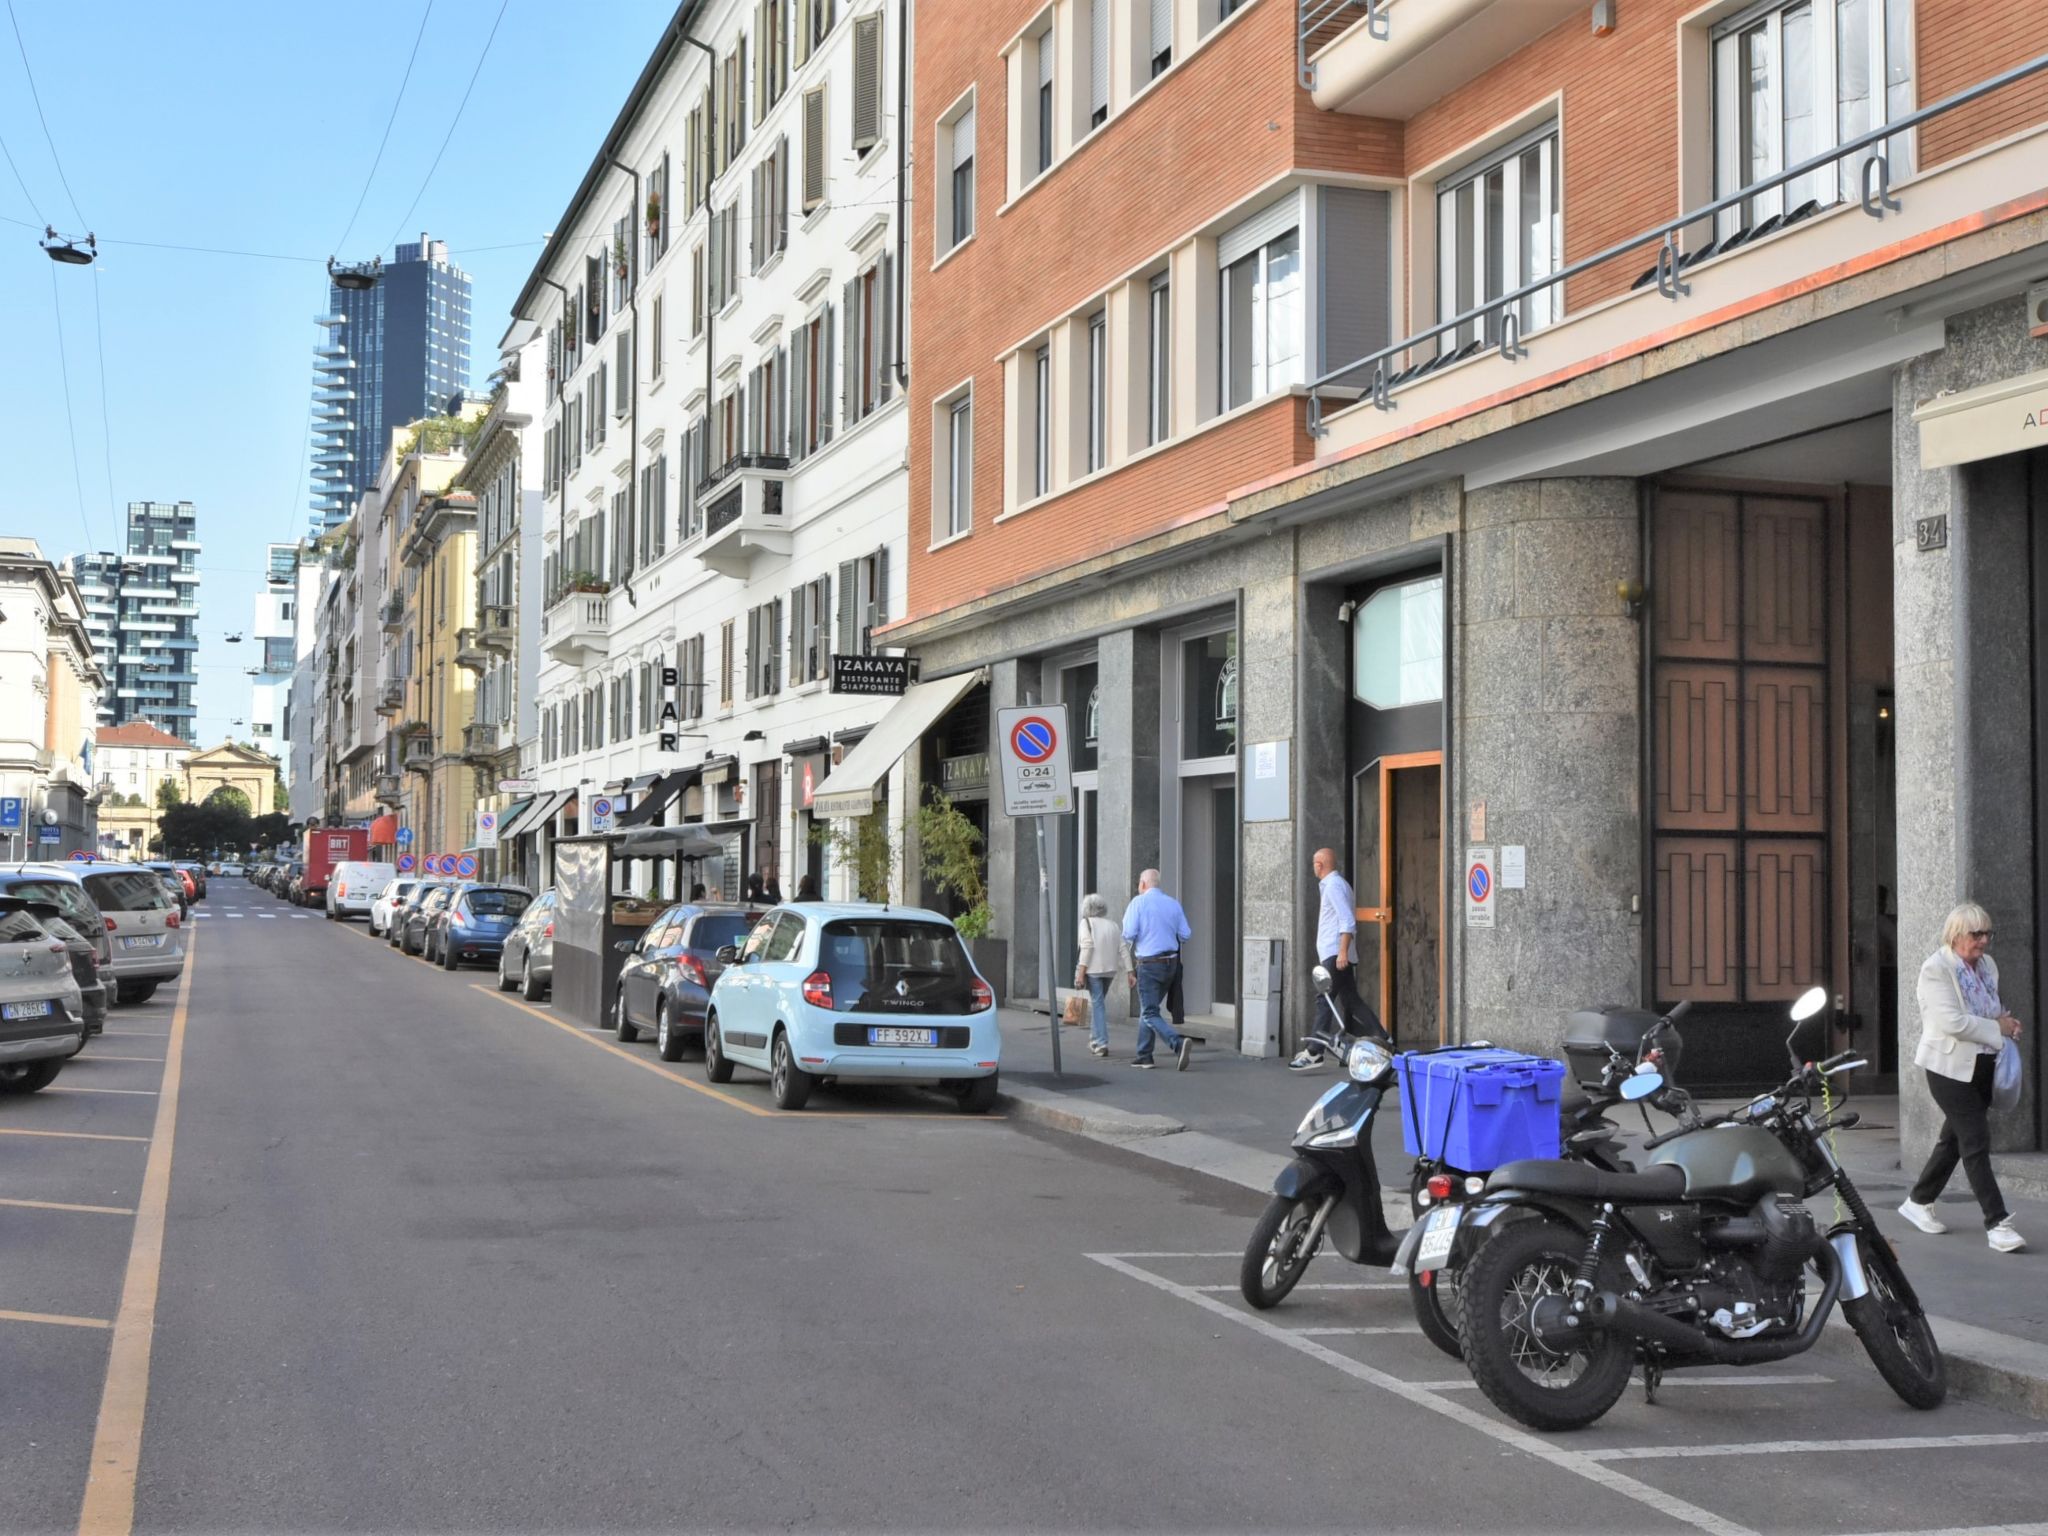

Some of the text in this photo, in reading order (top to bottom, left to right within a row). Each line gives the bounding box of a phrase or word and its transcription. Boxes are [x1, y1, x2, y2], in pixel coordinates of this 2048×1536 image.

[1918, 518, 1942, 546] 34
[837, 659, 905, 673] IZAKAYA
[841, 675, 900, 684] RISTORANTE
[841, 683, 900, 692] GIAPPONESE
[661, 667, 678, 752] BAR
[942, 757, 990, 781] IZAKAYA
[1022, 767, 1050, 778] 0-24
[4, 800, 16, 814] P
[330, 838, 348, 849] BRT
[876, 1029, 931, 1042] FF 392XJ
